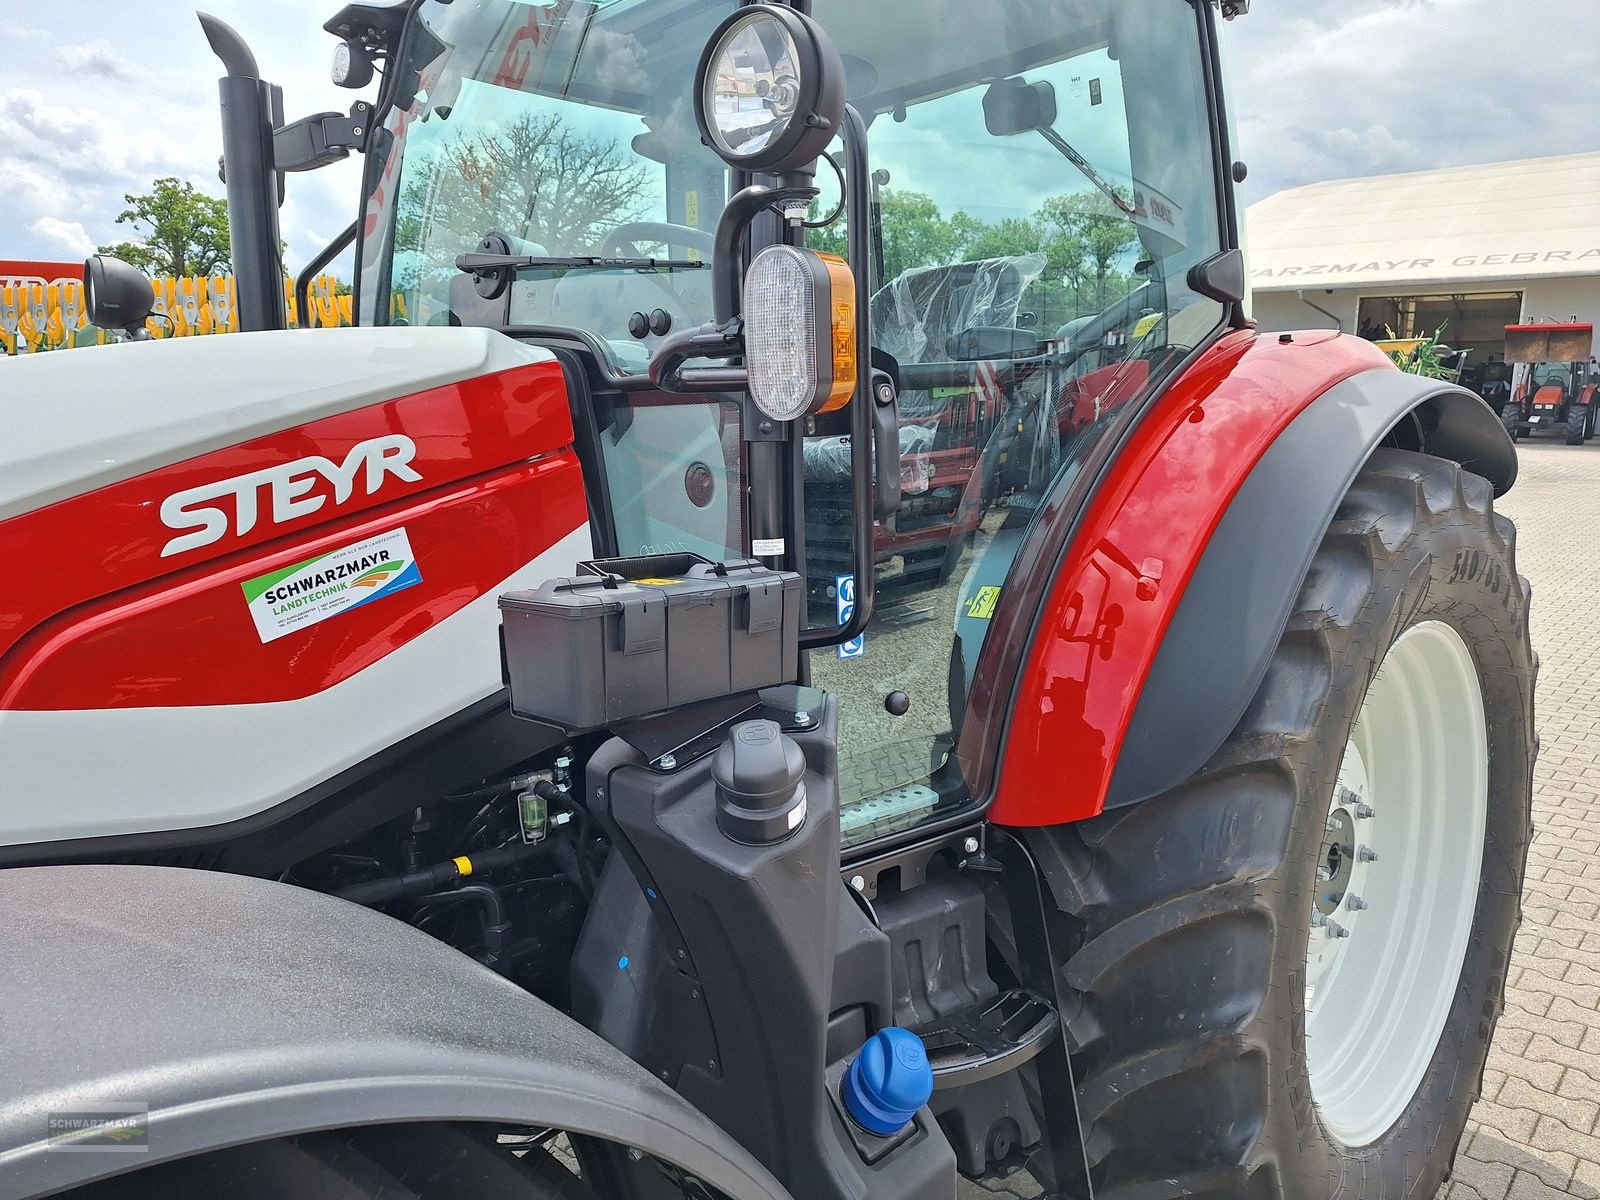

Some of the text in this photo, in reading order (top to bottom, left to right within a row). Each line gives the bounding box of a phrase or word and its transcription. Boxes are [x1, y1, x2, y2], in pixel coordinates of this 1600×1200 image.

[159, 433, 424, 558] STEYR
[332, 550, 347, 560] MEHR
[347, 547, 358, 556] ALS
[357, 543, 369, 553] NUR
[264, 549, 391, 605] SCHWARZMAYR
[272, 581, 348, 616] LANDTECHNIK
